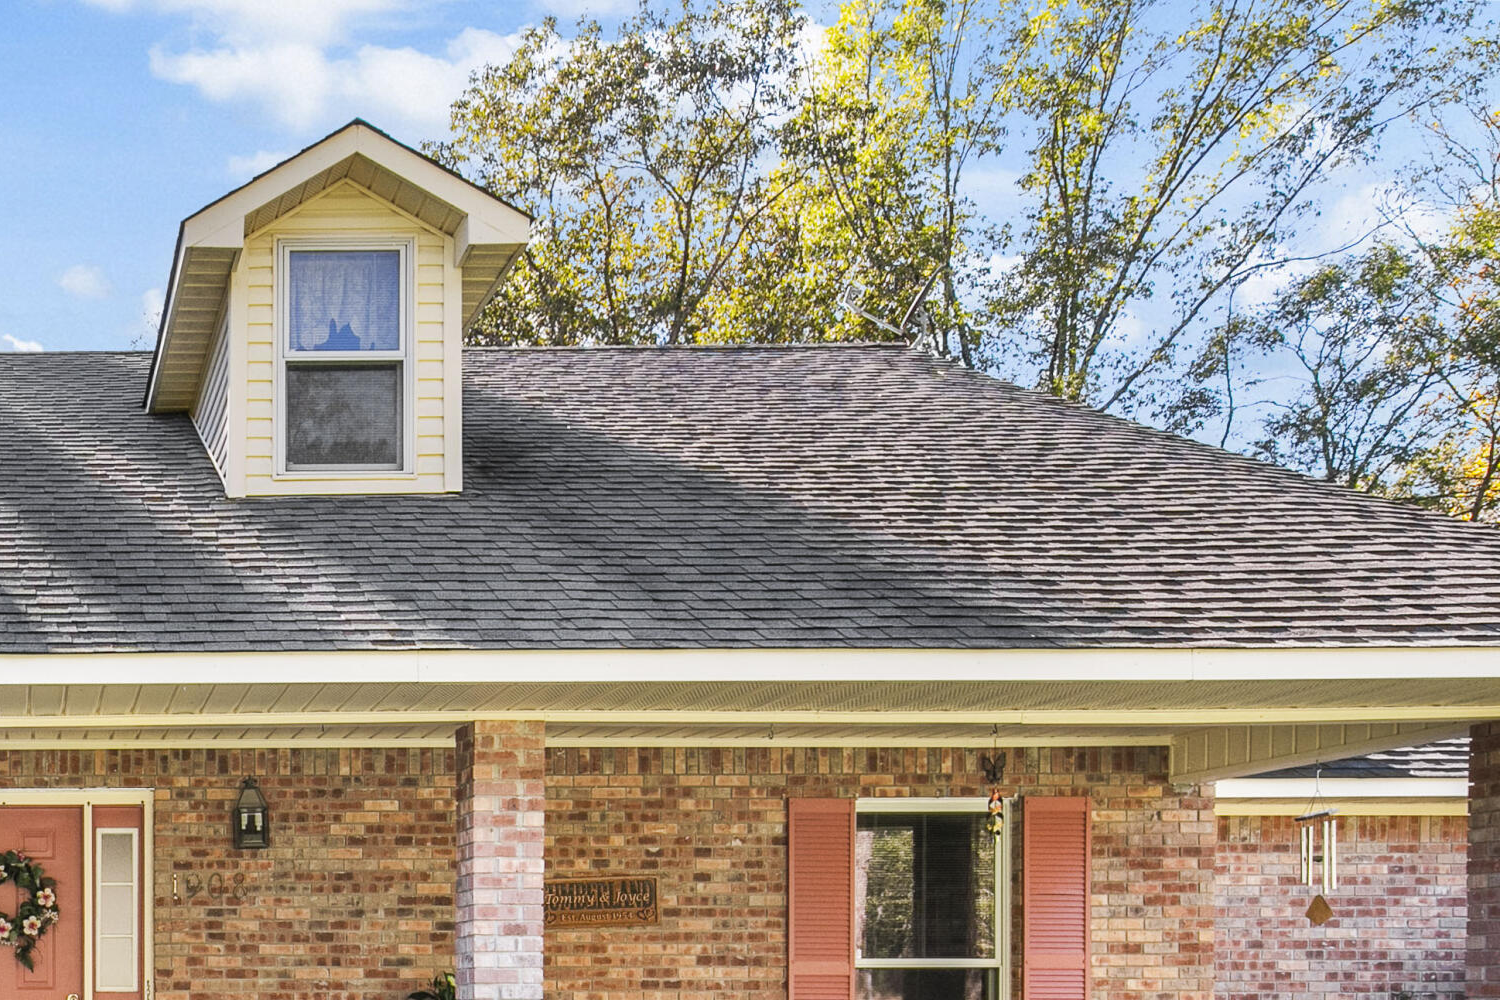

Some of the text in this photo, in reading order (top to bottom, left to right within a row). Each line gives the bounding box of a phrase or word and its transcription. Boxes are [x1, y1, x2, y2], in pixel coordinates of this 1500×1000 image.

[172, 871, 248, 900] 1908
[544, 890, 651, 907] Tommy & Joyce
[581, 913, 609, 922] August
